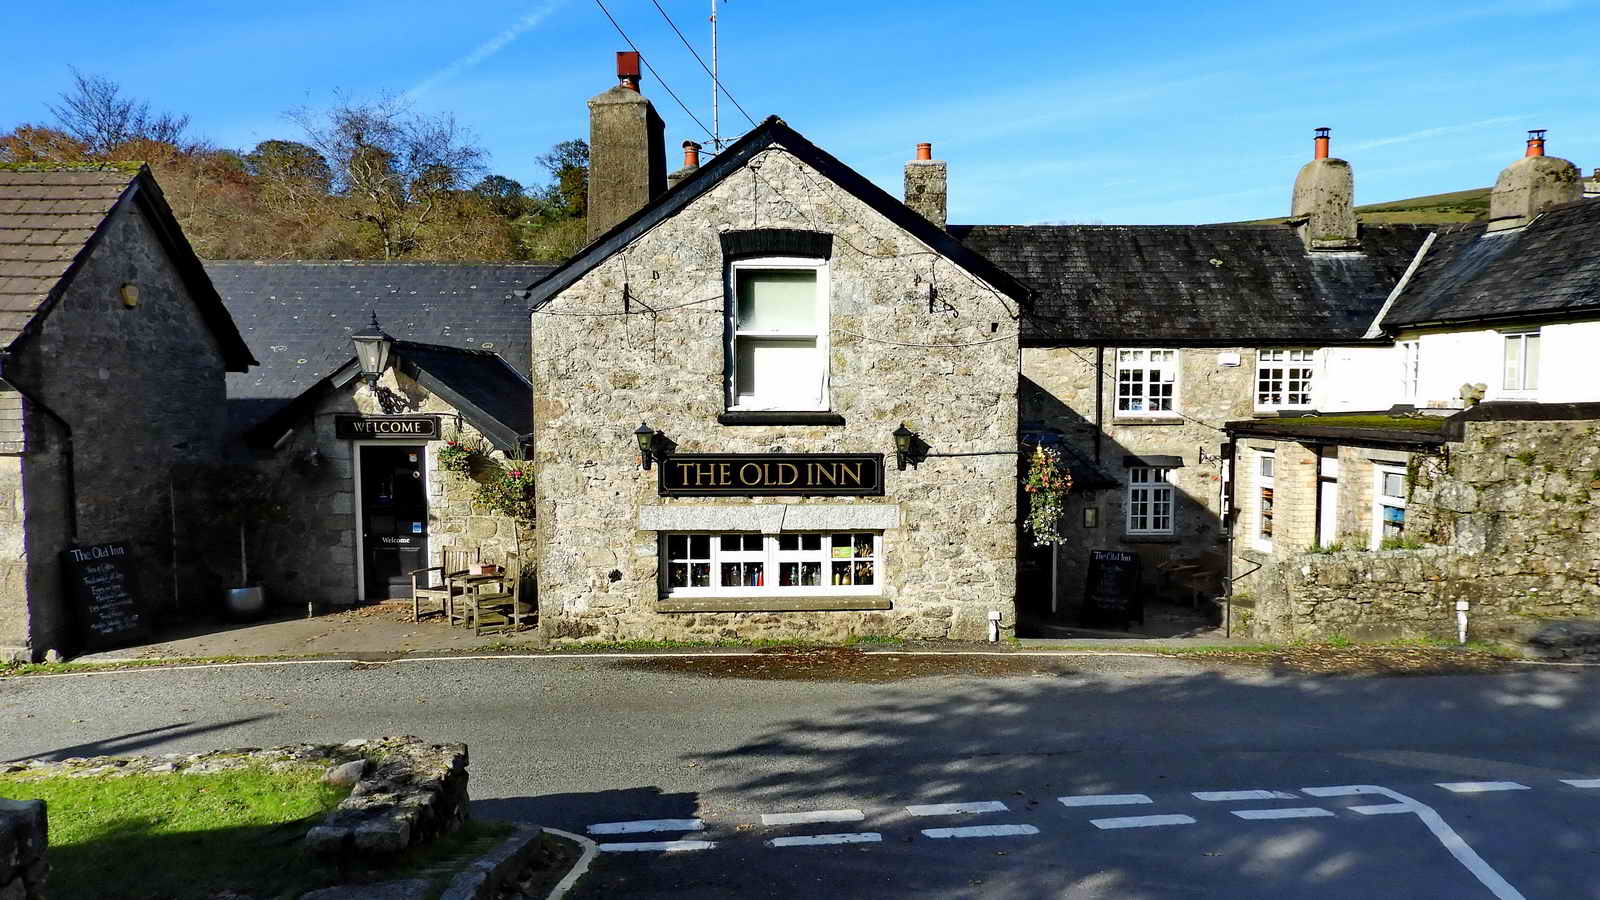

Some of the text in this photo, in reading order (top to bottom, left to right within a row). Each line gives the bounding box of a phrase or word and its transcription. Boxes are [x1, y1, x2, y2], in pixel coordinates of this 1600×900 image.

[352, 422, 421, 433] WELCOME
[677, 463, 862, 486] THE OLD INN
[382, 536, 411, 544] Welcome
[70, 545, 125, 562] The Old Inn
